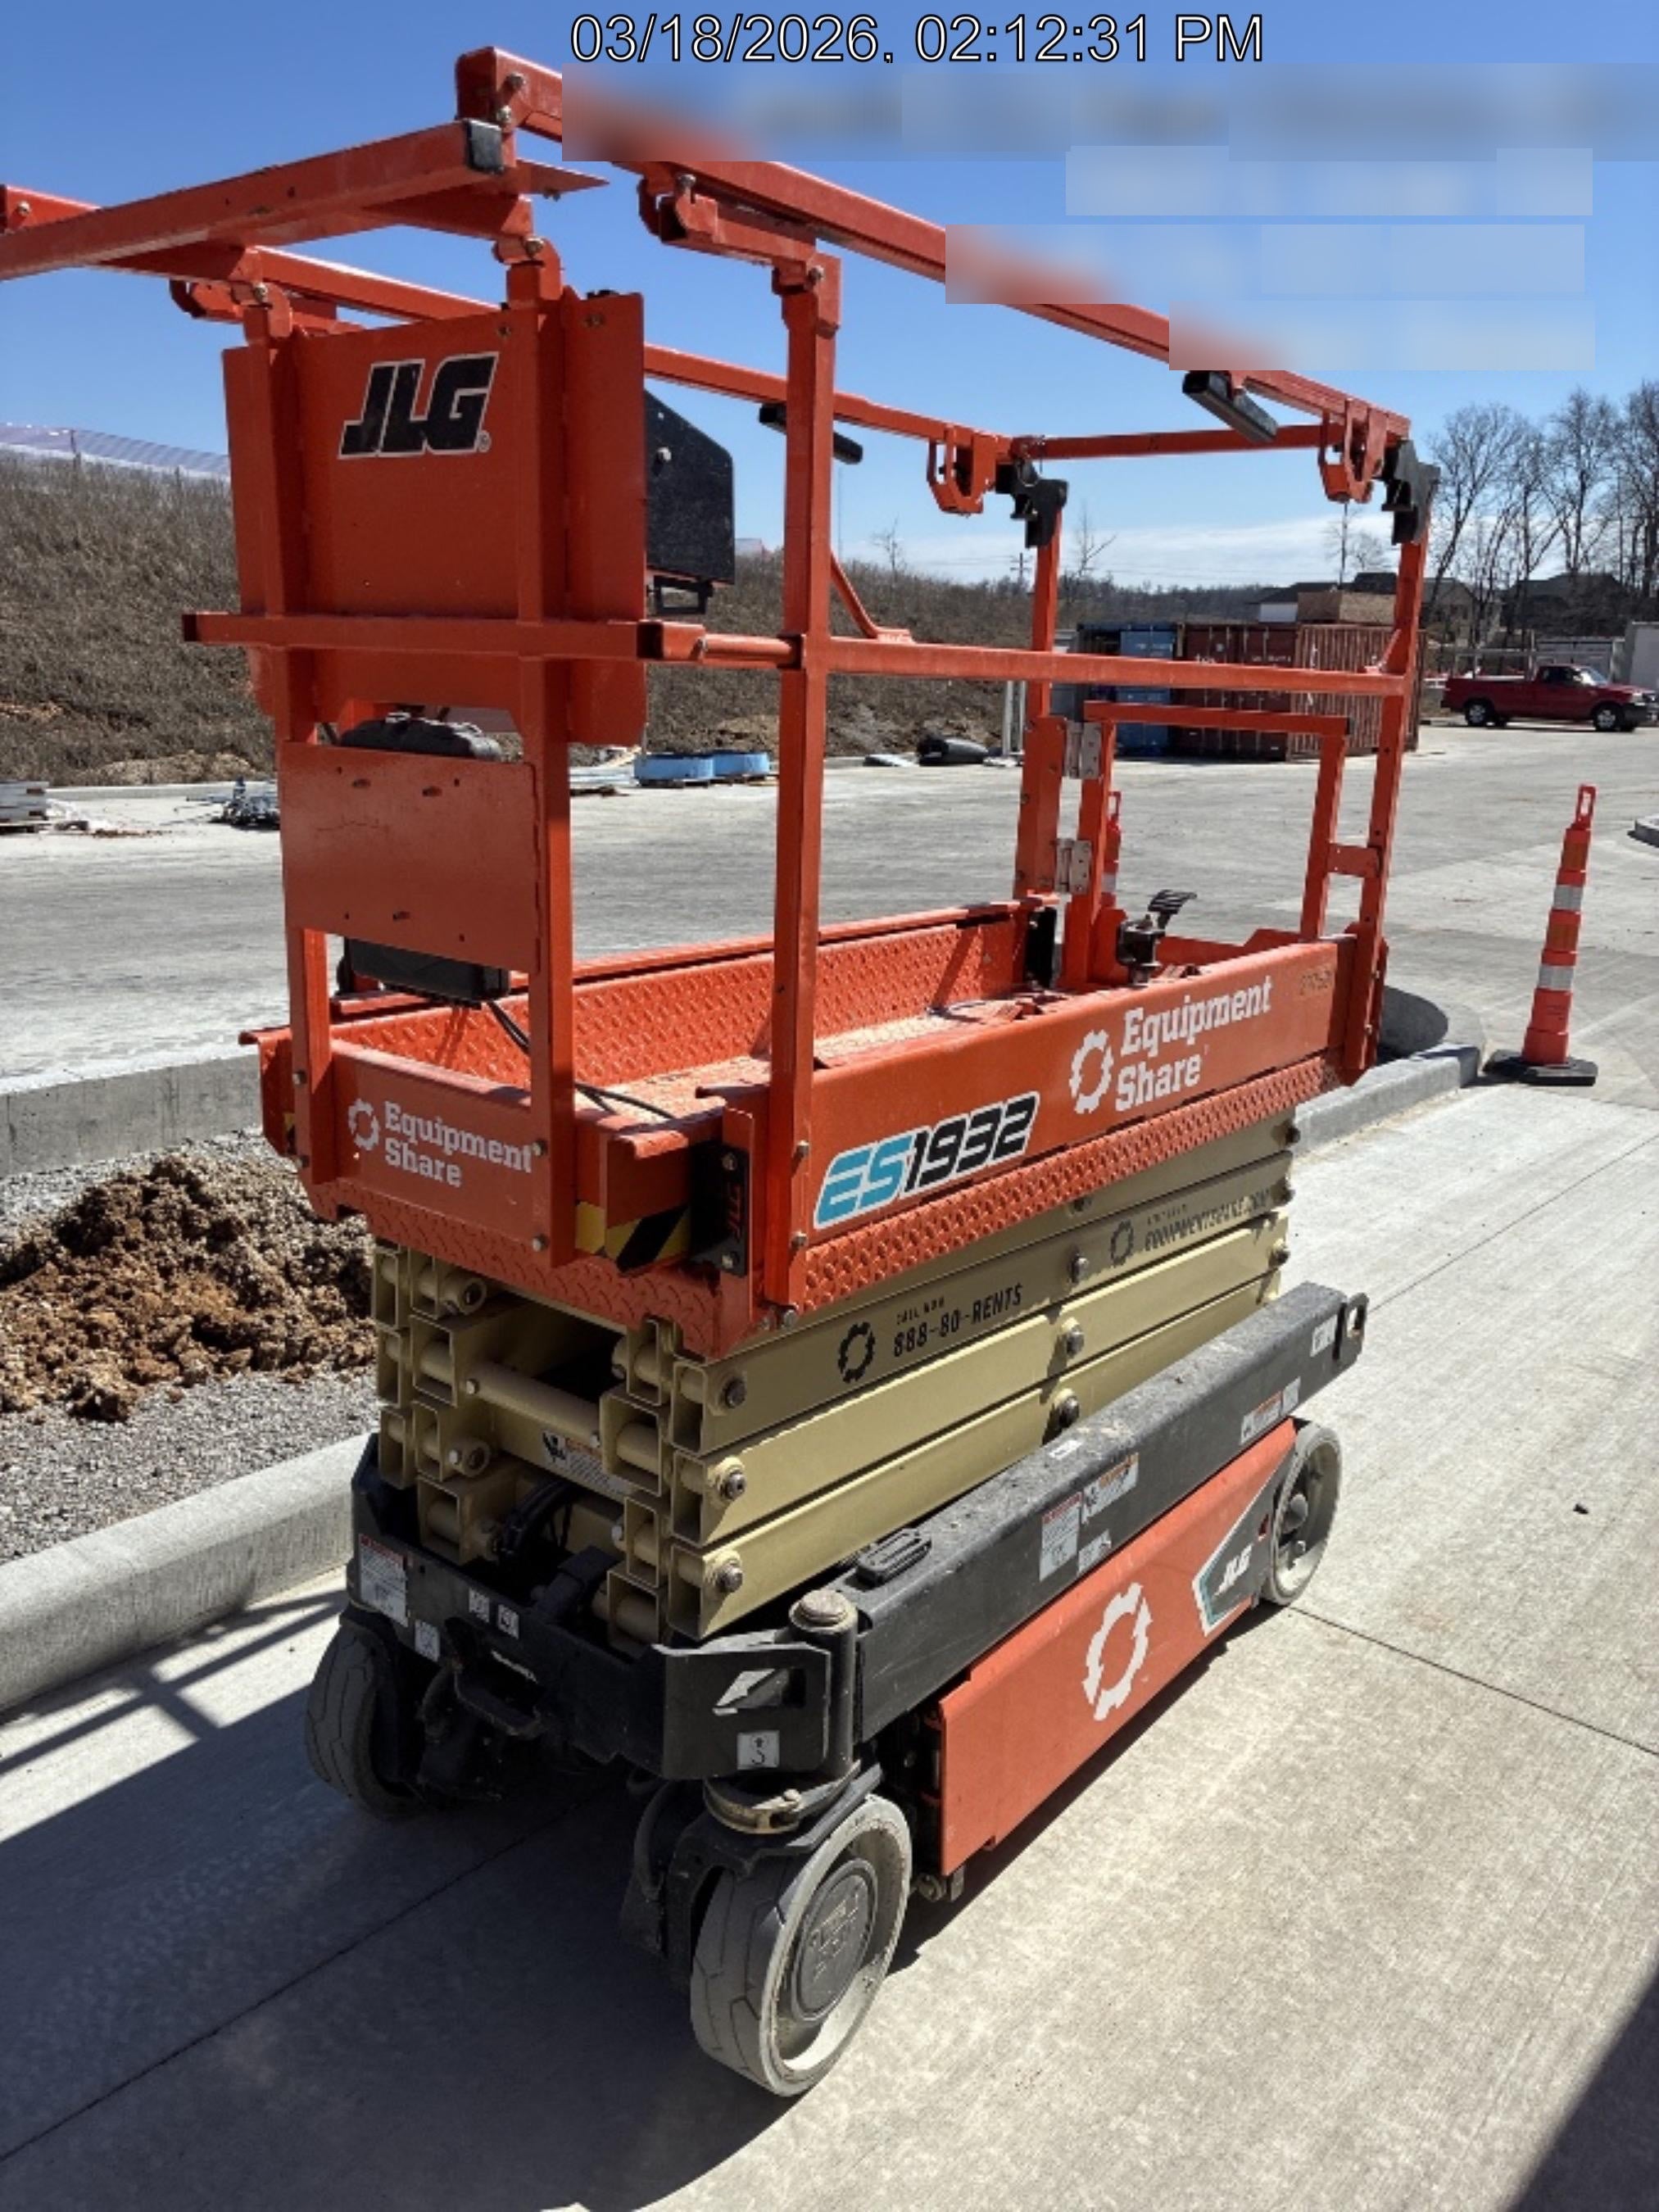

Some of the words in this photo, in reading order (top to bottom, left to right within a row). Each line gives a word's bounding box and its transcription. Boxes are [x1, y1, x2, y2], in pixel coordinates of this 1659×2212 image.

[338, 351, 499, 459] JLG
[1121, 975, 1271, 1057] Equipment
[1115, 1054, 1202, 1111] Share
[384, 1100, 533, 1173] Equipment
[384, 1137, 462, 1187] Share
[814, 1090, 1040, 1229] ES1932
[894, 1282, 1023, 1358] 888-80-RENTS
